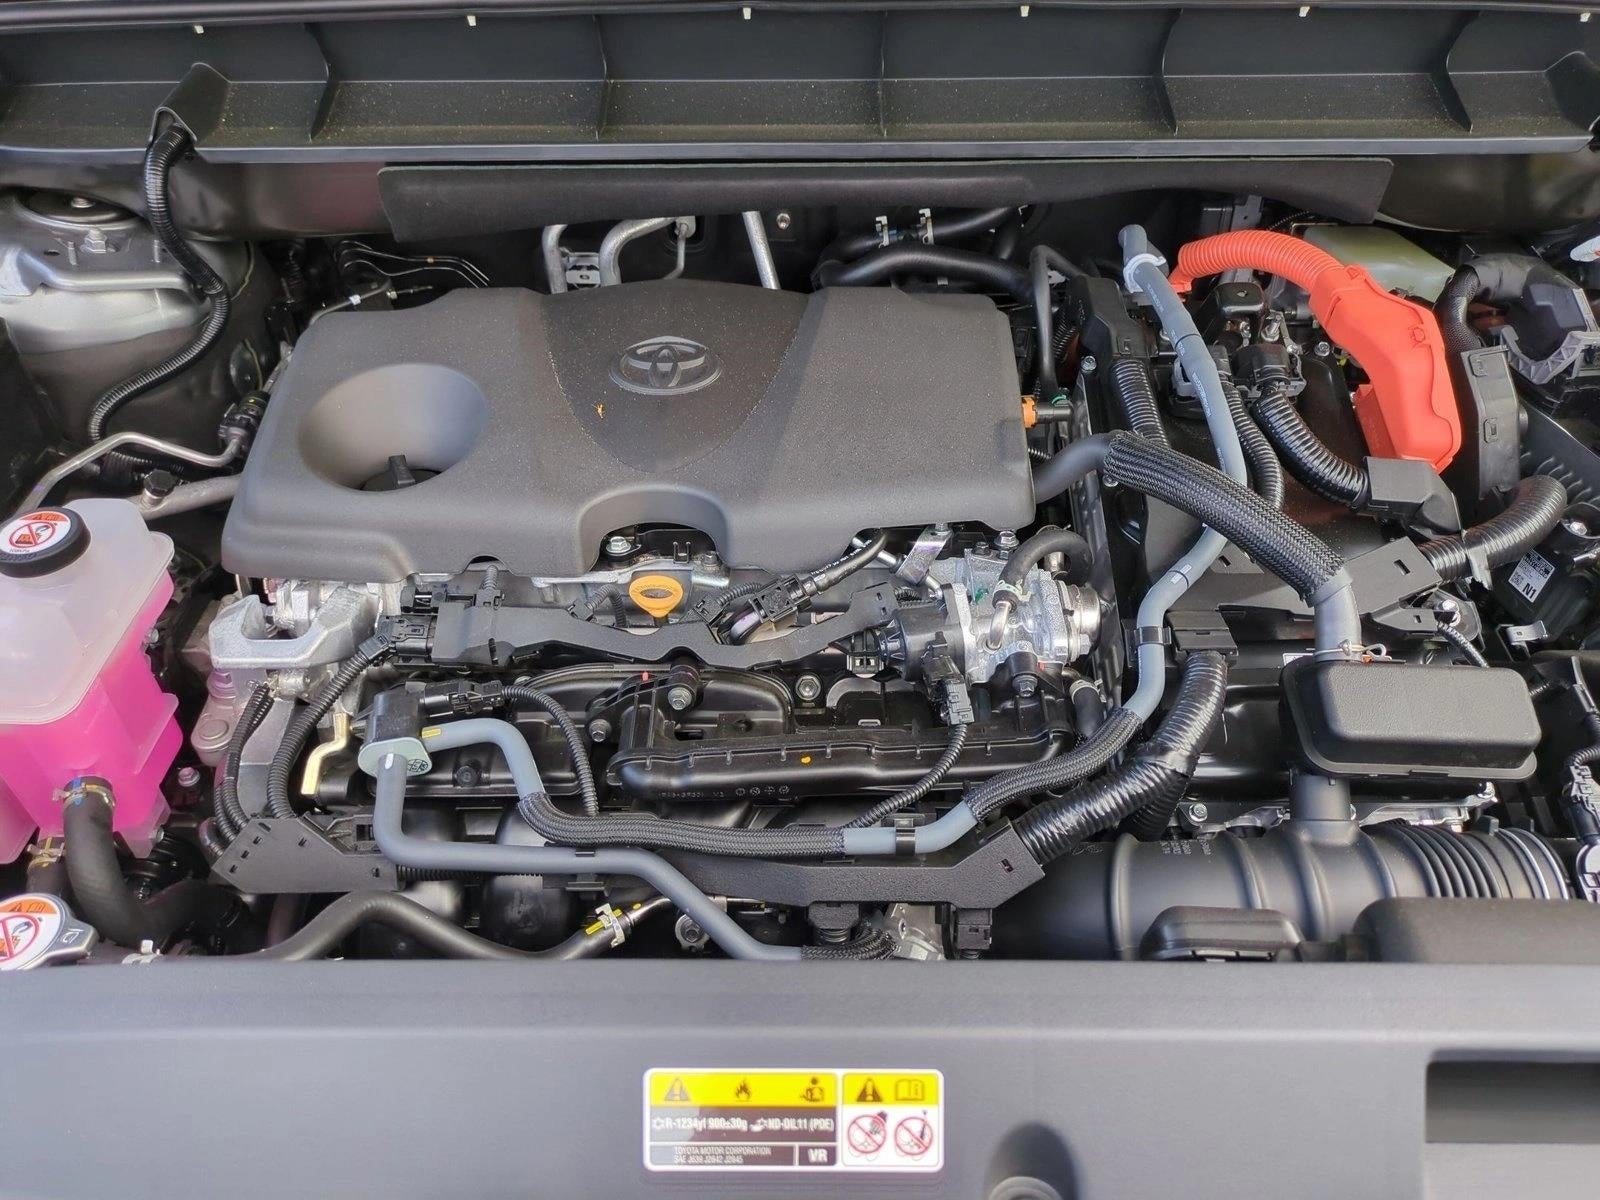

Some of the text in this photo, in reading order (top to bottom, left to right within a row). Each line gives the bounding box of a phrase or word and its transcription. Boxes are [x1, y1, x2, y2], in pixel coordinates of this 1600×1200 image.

[1522, 583, 1537, 599] N1
[665, 1117, 706, 1131] R-1234yf
[809, 1117, 835, 1132] (POE)
[674, 1146, 771, 1156] TOYOTA MOTOR CORPORATION
[808, 1148, 828, 1163] VR
